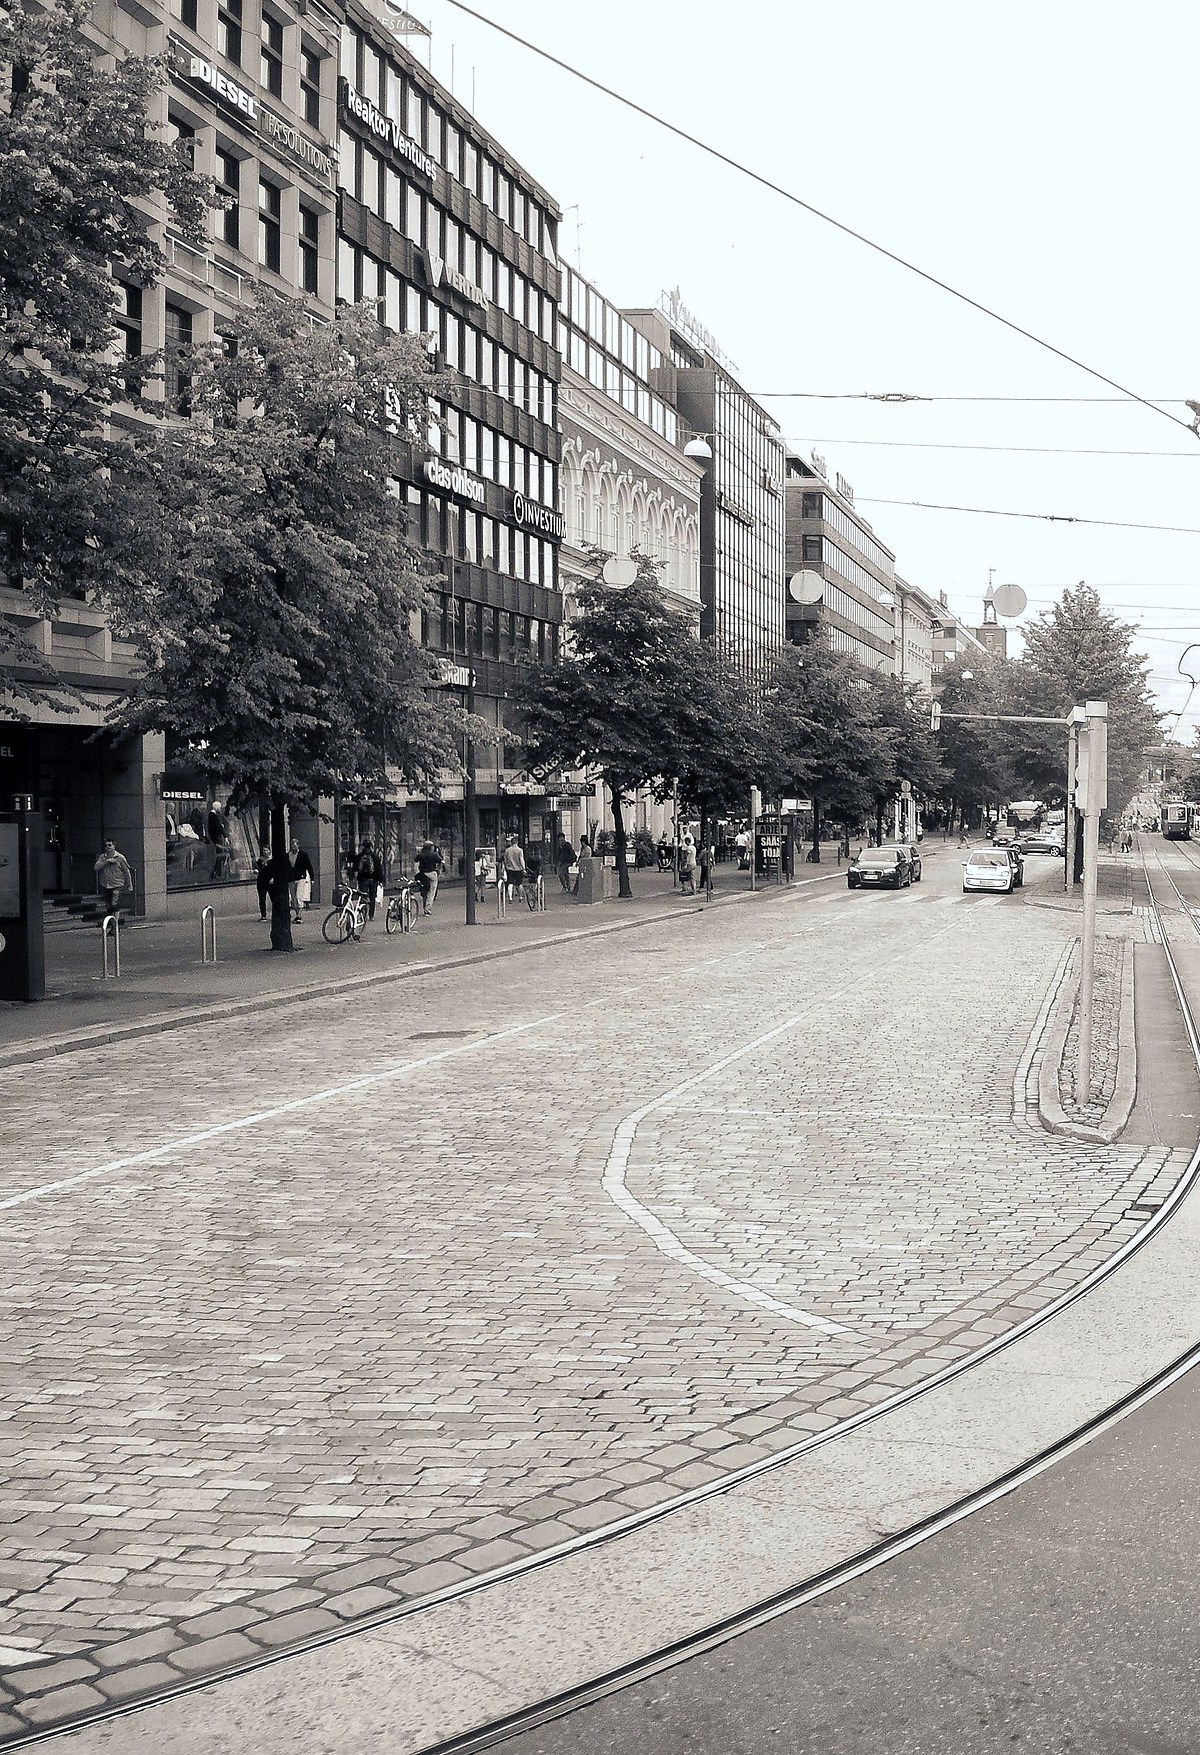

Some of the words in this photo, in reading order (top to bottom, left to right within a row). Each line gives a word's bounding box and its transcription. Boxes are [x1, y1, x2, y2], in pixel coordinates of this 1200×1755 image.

[199, 57, 258, 121] DIESEL
[348, 84, 391, 141] Reaktor
[391, 121, 437, 181] Ventures
[427, 455, 451, 490] clas
[451, 466, 485, 504] ohlson
[525, 502, 567, 538] INVESTIUM
[162, 791, 204, 799] DIESEL
